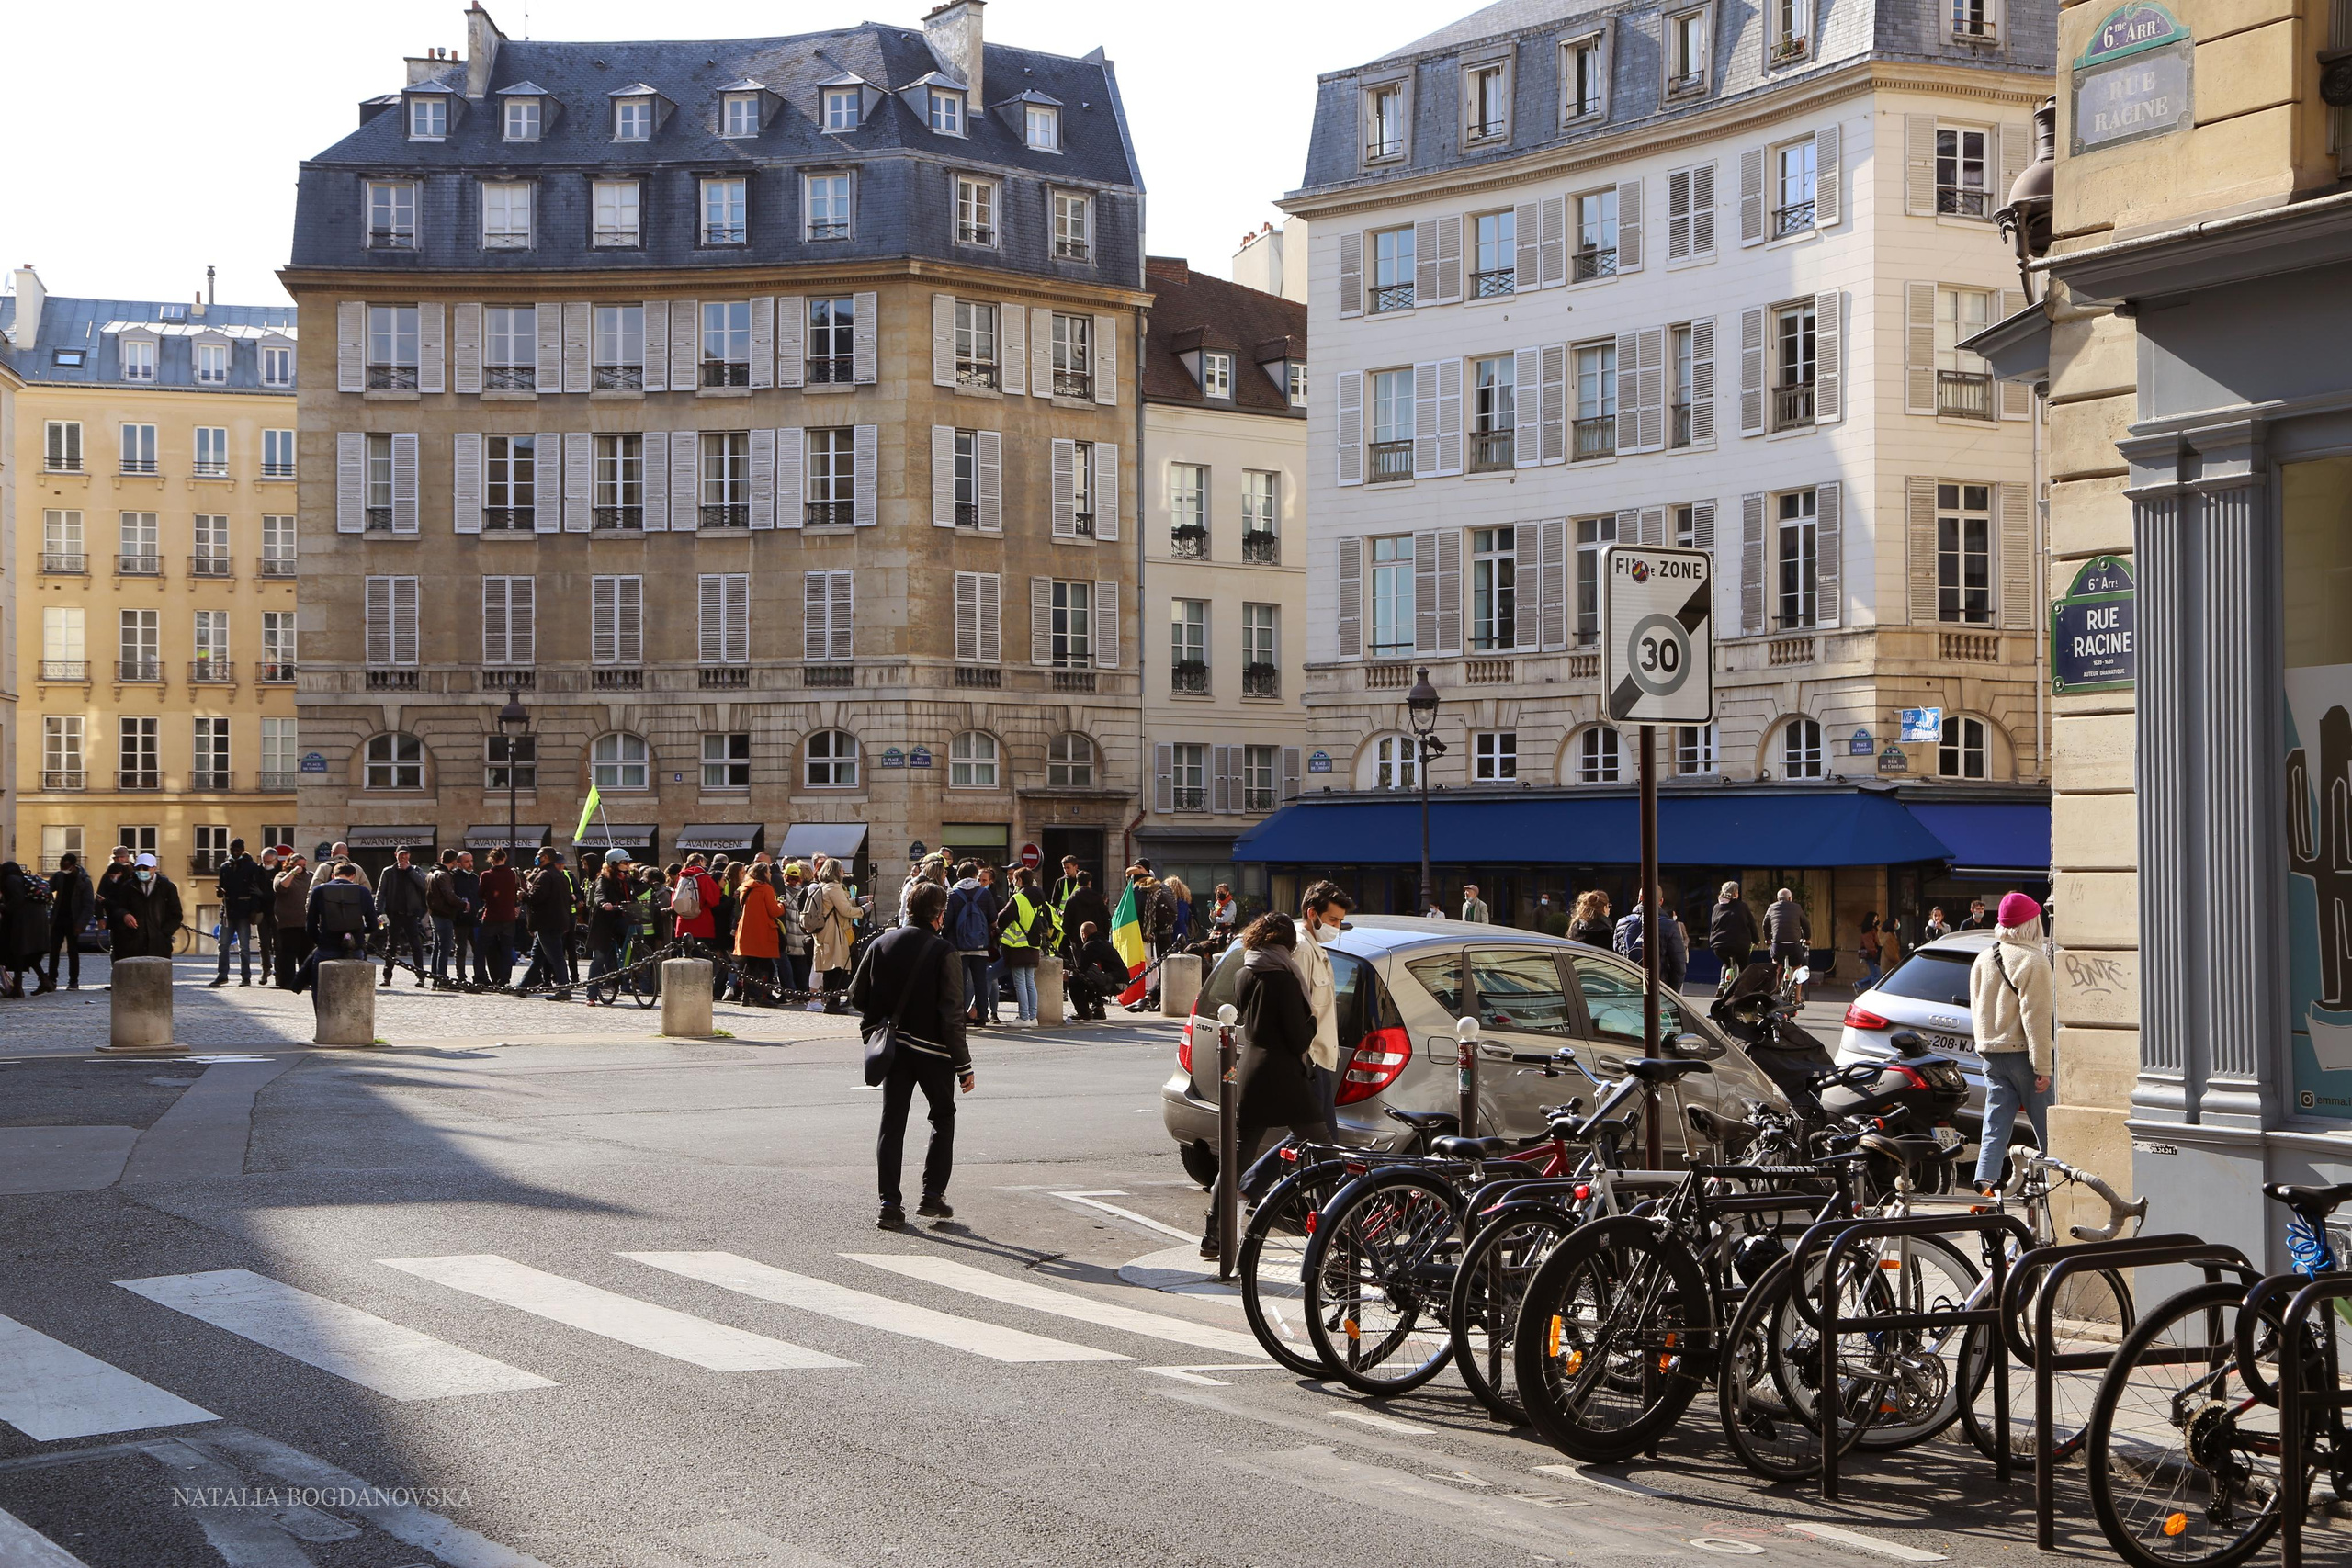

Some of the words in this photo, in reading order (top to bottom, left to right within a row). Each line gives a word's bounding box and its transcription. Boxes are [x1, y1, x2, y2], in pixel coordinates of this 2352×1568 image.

[2109, 72, 2155, 101] RUE
[2094, 96, 2168, 132] RACINE
[1660, 560, 1702, 579] ZONE
[2086, 607, 2120, 630] RUE
[1641, 637, 1679, 673] 30
[2074, 632, 2132, 658] RACINE
[2099, 668, 2125, 676] DRAMATIQUE
